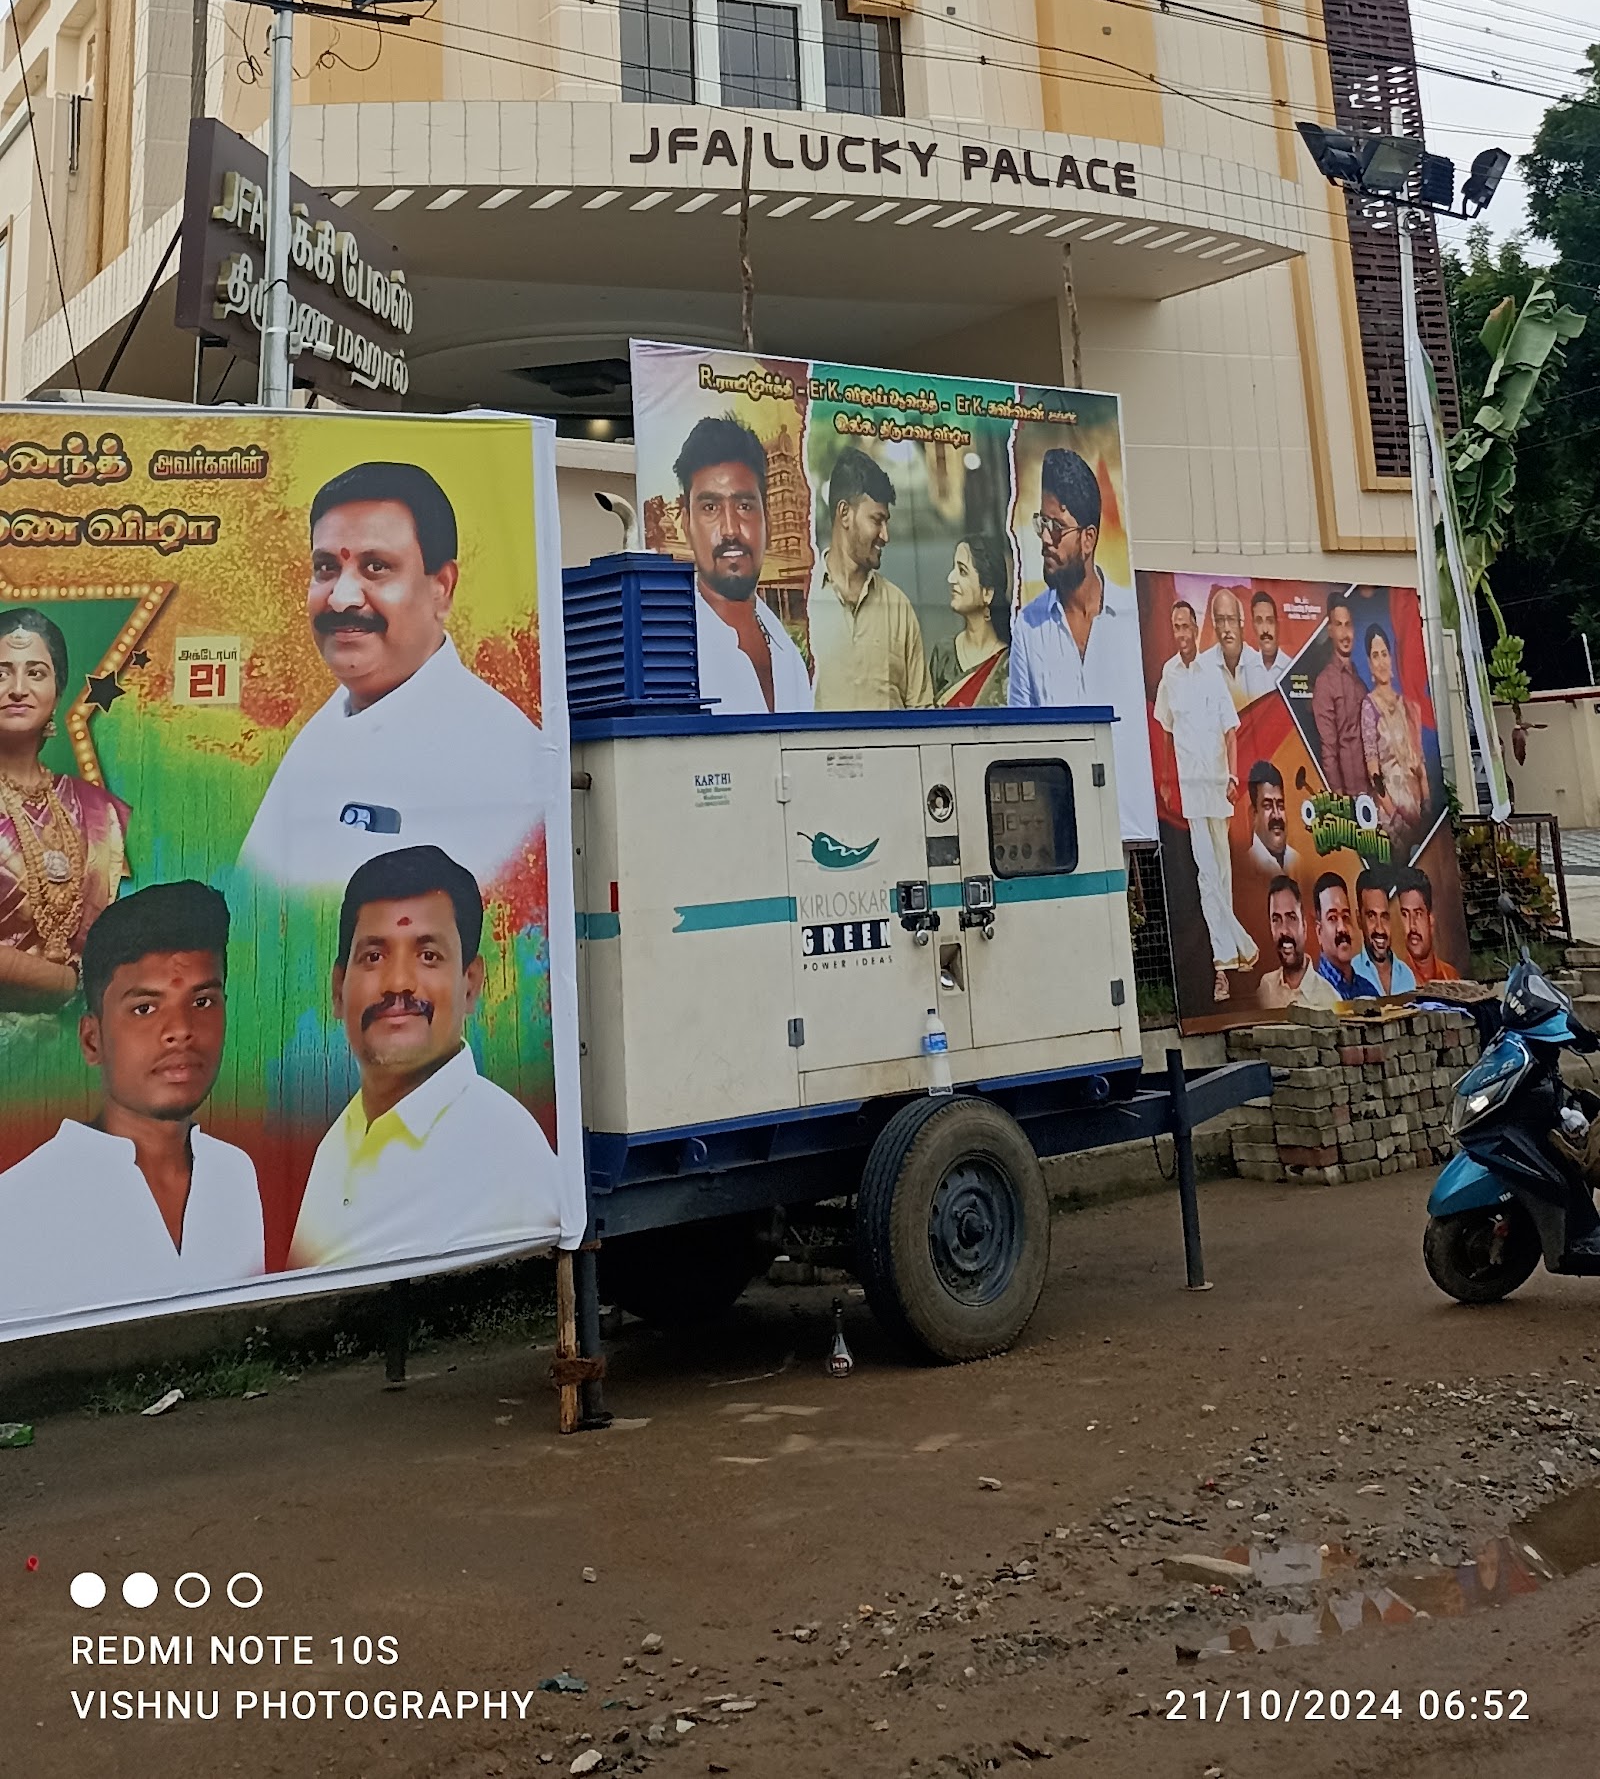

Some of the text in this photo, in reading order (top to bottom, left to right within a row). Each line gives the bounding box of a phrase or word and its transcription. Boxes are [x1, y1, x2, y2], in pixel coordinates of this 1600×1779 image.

[630, 127, 1137, 197] JFA LUCKY PALACE
[214, 172, 414, 335] JFA க்கி பேலஸ்
[336, 324, 410, 396] மஹால்
[0, 435, 266, 483] னந்த் அவர்களின்
[0, 508, 218, 552] ண விழா
[178, 648, 238, 662] அக்டோபர்
[189, 663, 226, 698] 21
[694, 773, 732, 786] KARTHI
[800, 889, 888, 919] KIRLOSKAR
[802, 920, 891, 955] GREEN
[803, 955, 893, 971] POWER IDEAS
